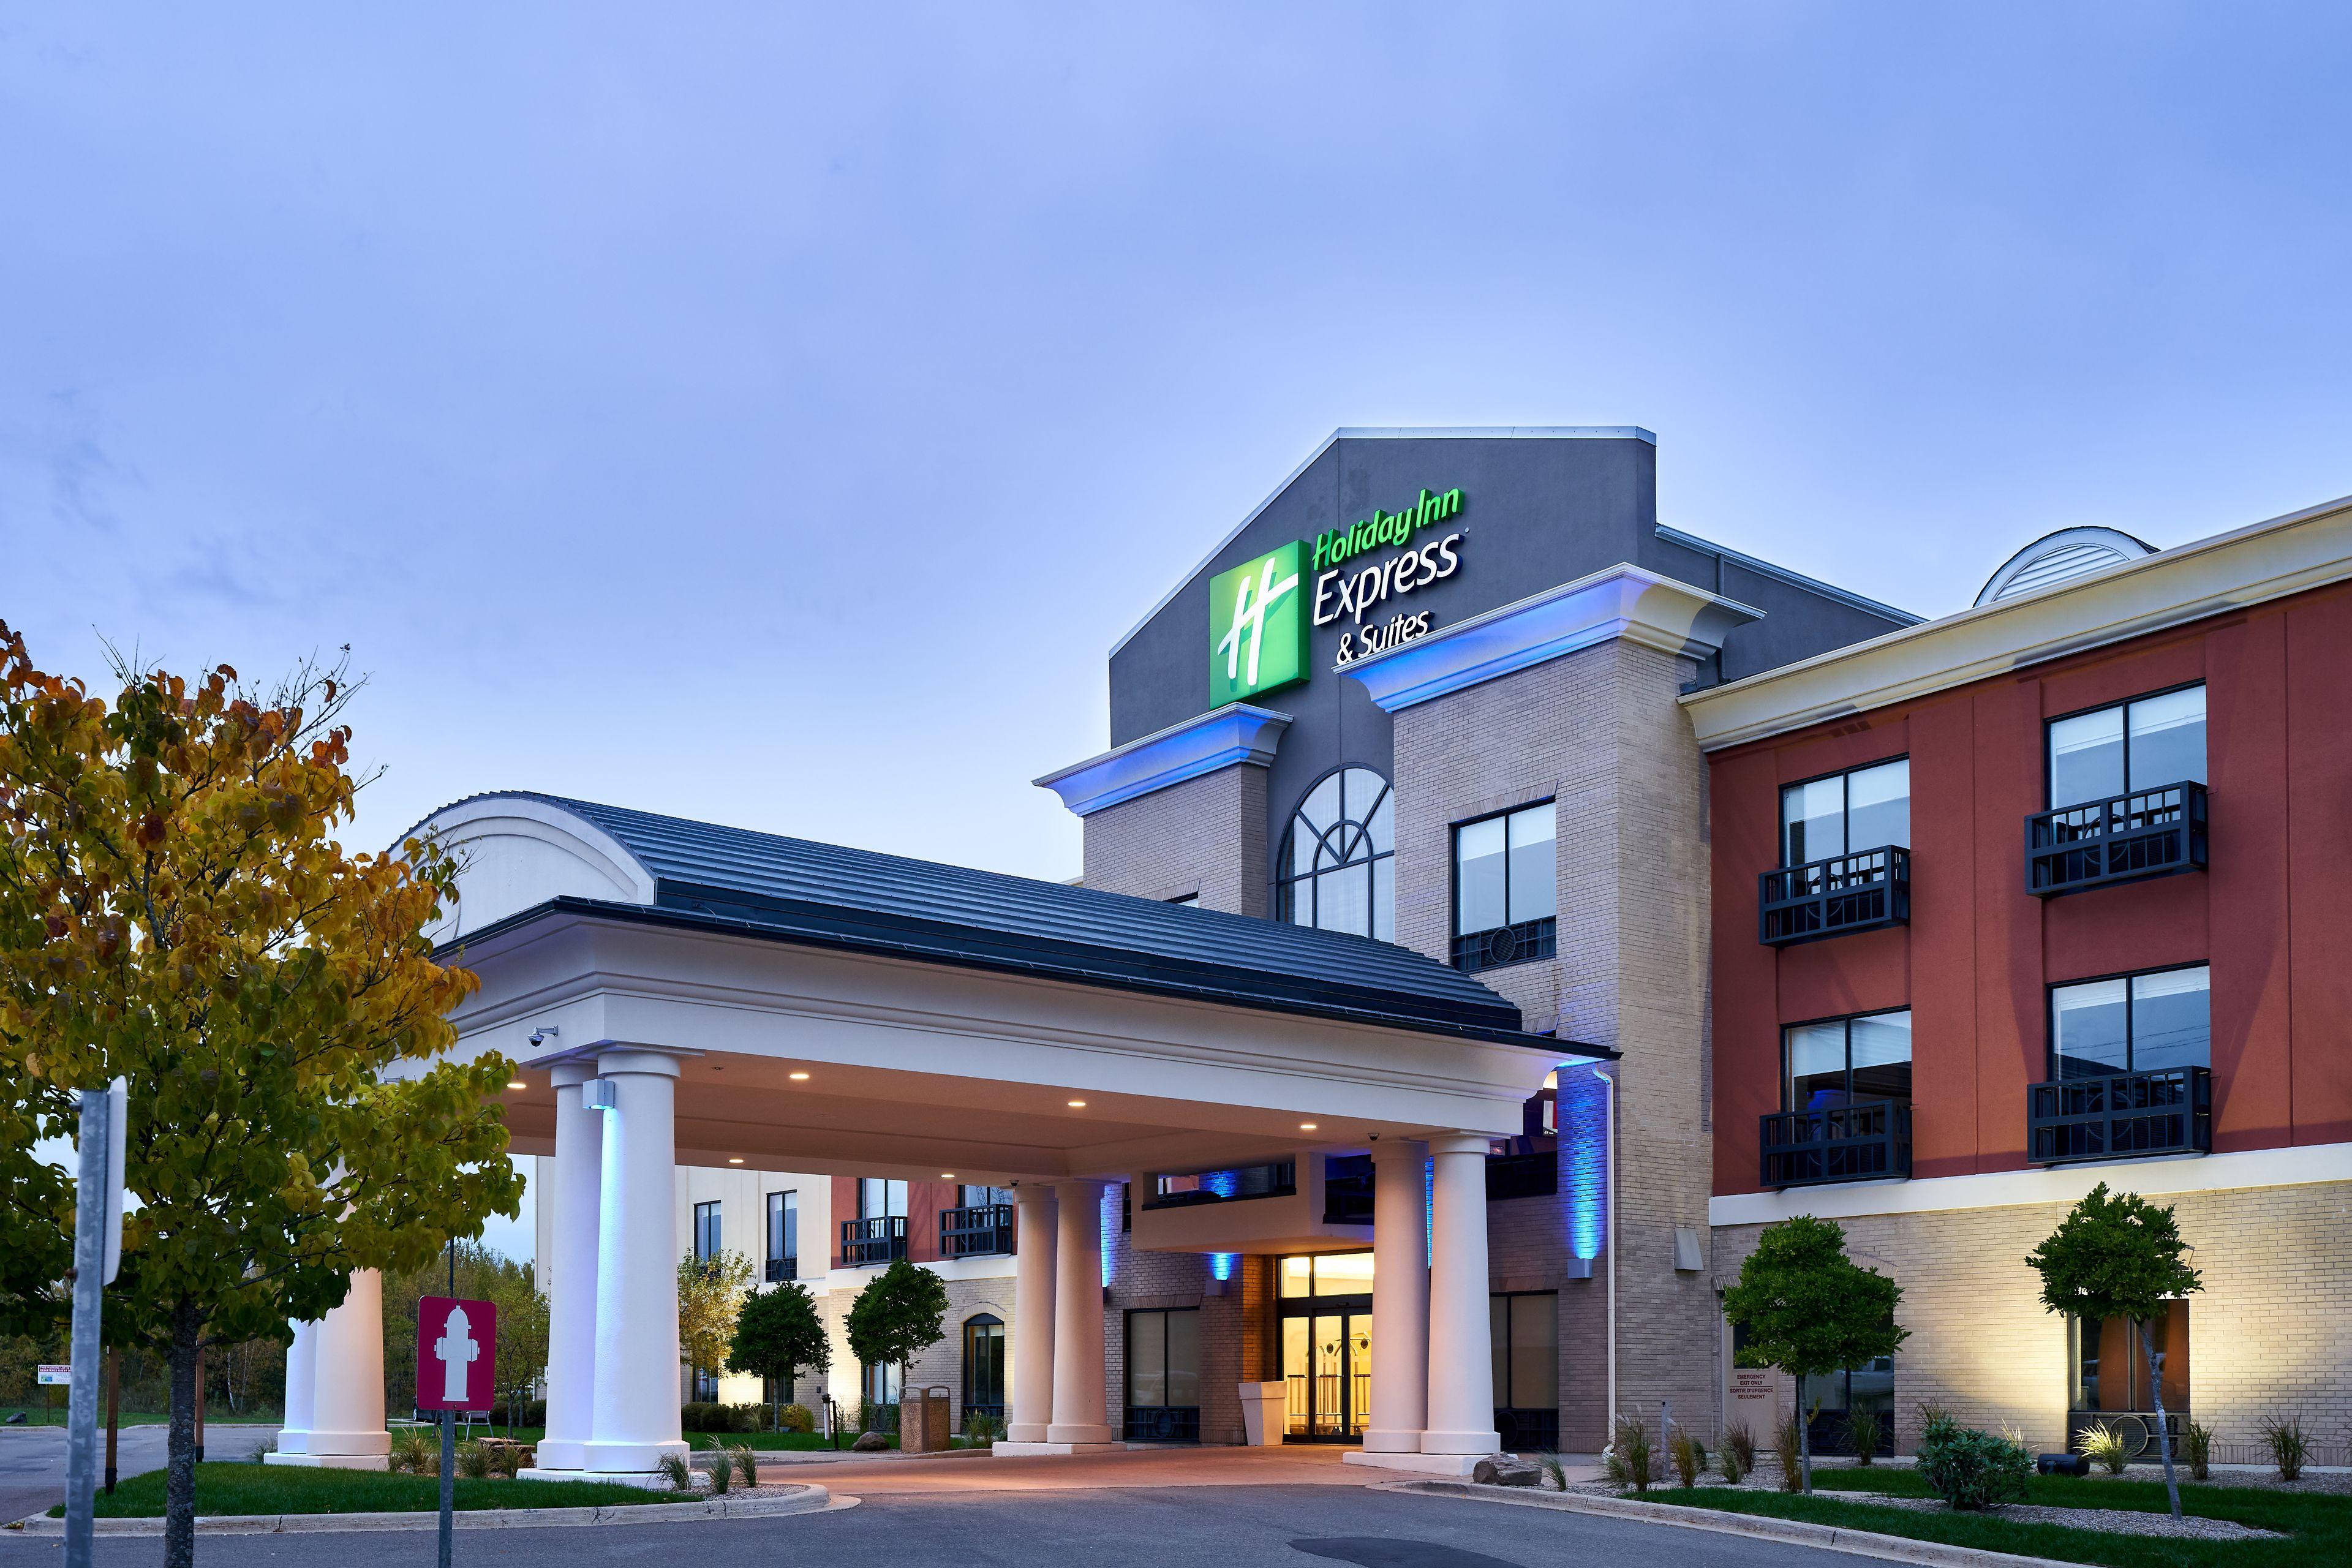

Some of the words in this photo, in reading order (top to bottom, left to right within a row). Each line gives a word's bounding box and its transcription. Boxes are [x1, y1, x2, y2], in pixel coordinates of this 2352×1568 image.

[1312, 509, 1414, 571] Holiday
[1415, 488, 1461, 529] Inn
[1313, 533, 1460, 626] Express
[1336, 632, 1354, 665] &
[1357, 611, 1430, 657] Suites
